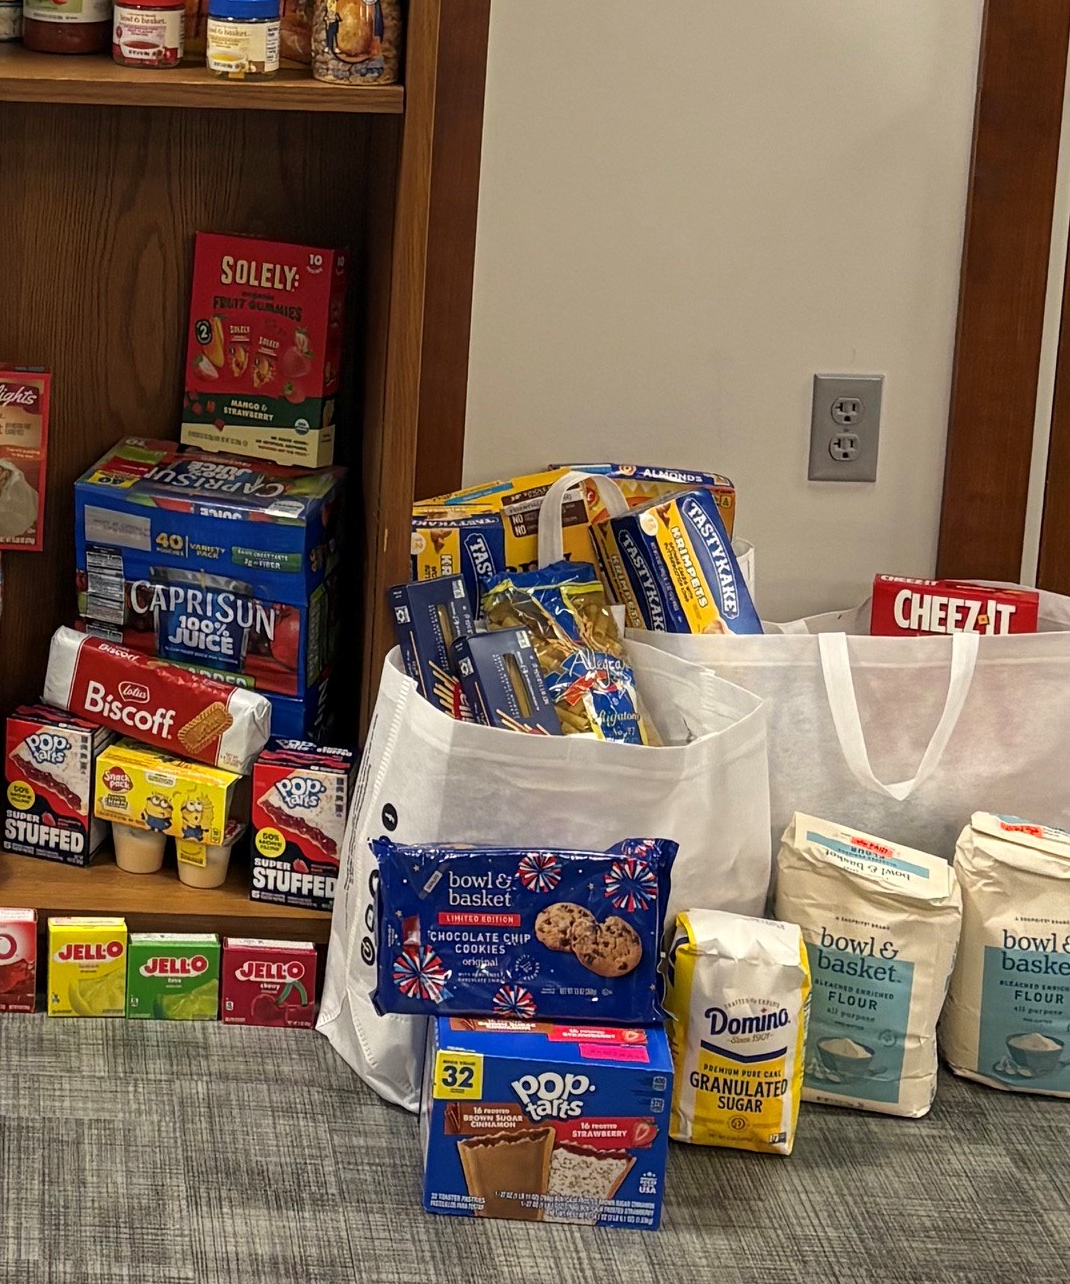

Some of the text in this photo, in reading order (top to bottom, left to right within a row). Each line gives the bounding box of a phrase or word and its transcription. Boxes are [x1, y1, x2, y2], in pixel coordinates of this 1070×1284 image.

[643, 468, 703, 484] ALMONDS
[156, 533, 183, 550] 40
[688, 501, 738, 614] TASTYKAKE
[179, 615, 230, 637] 100%
[168, 627, 234, 655] JUICE
[85, 680, 175, 739] Biscoff
[4, 820, 84, 854] STUFFED
[449, 871, 511, 889] bowl &
[449, 889, 511, 906] basket
[446, 915, 479, 923] LIMITED
[430, 931, 531, 944] CHOCOLATE CHIP
[821, 927, 899, 959] bowl &
[455, 944, 506, 954] COOKIES
[818, 949, 896, 983] basket
[828, 991, 878, 1011] FLOUR
[705, 1007, 790, 1035] Domino
[442, 1066, 474, 1088] 32
[690, 1071, 788, 1098] GRANULATED
[525, 1099, 584, 1120] tarts
[718, 1096, 762, 1113] SUGAR
[572, 1130, 627, 1138] STRAWBERRY
